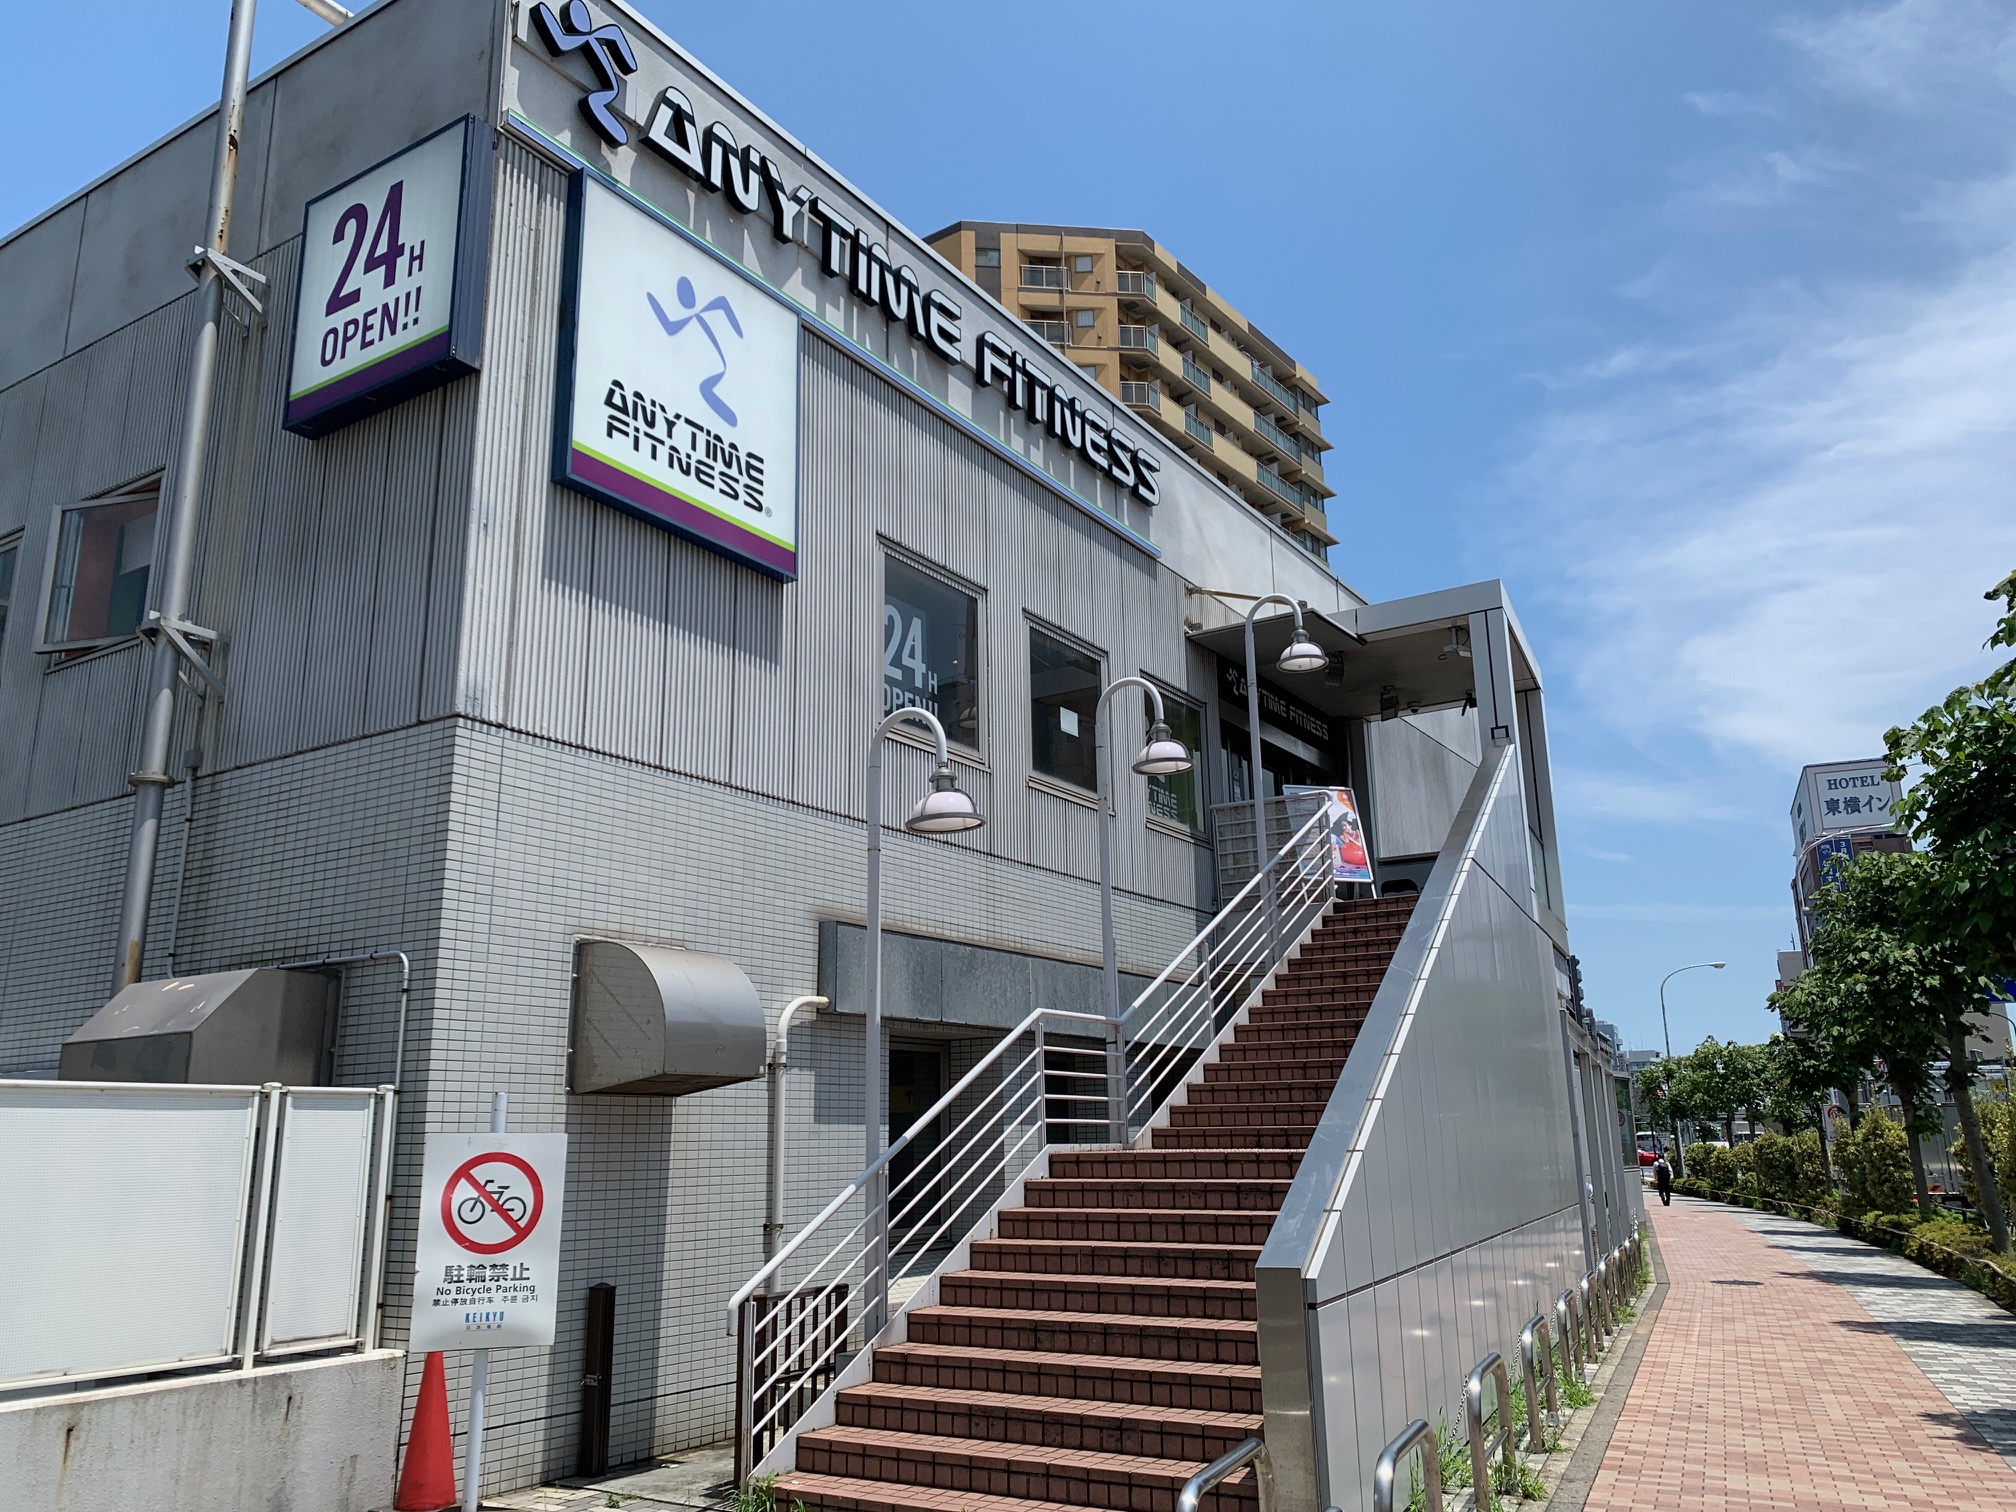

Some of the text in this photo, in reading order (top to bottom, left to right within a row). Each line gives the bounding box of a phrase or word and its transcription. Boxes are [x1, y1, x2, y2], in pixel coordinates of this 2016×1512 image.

[638, 86, 1161, 506] ANYTIME FITNESS
[320, 286, 422, 368] OPEN!!
[604, 379, 764, 487] ANYTIME
[1826, 775, 1880, 790] HOTEL
[1824, 795, 1891, 816] 東横イン
[443, 1262, 530, 1284] 駐輪禁止
[436, 1283, 536, 1296] No Bicycle Parking
[432, 1297, 494, 1307] 禁止停放自行车
[465, 1311, 505, 1323] KEIKYU
